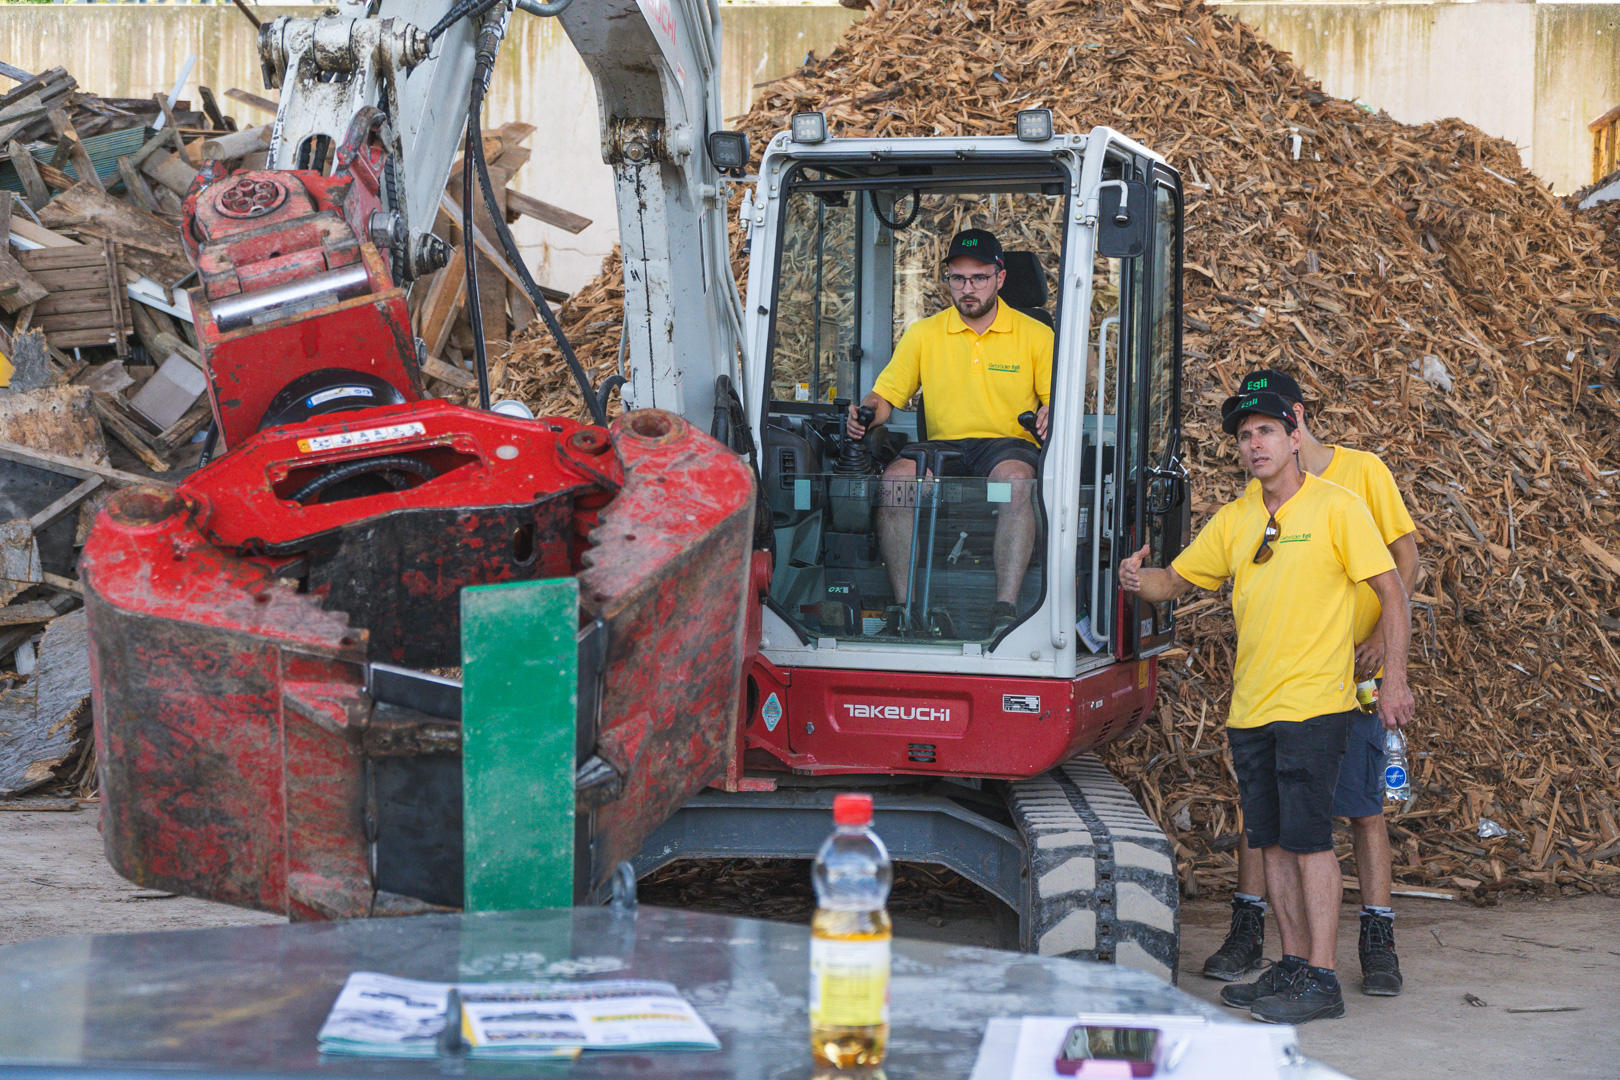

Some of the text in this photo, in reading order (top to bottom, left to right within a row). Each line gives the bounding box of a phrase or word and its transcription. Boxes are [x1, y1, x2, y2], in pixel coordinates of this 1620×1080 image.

[962, 238, 978, 247] Egli
[1247, 378, 1268, 391] Egli
[843, 704, 950, 722] TAKEUCHI
